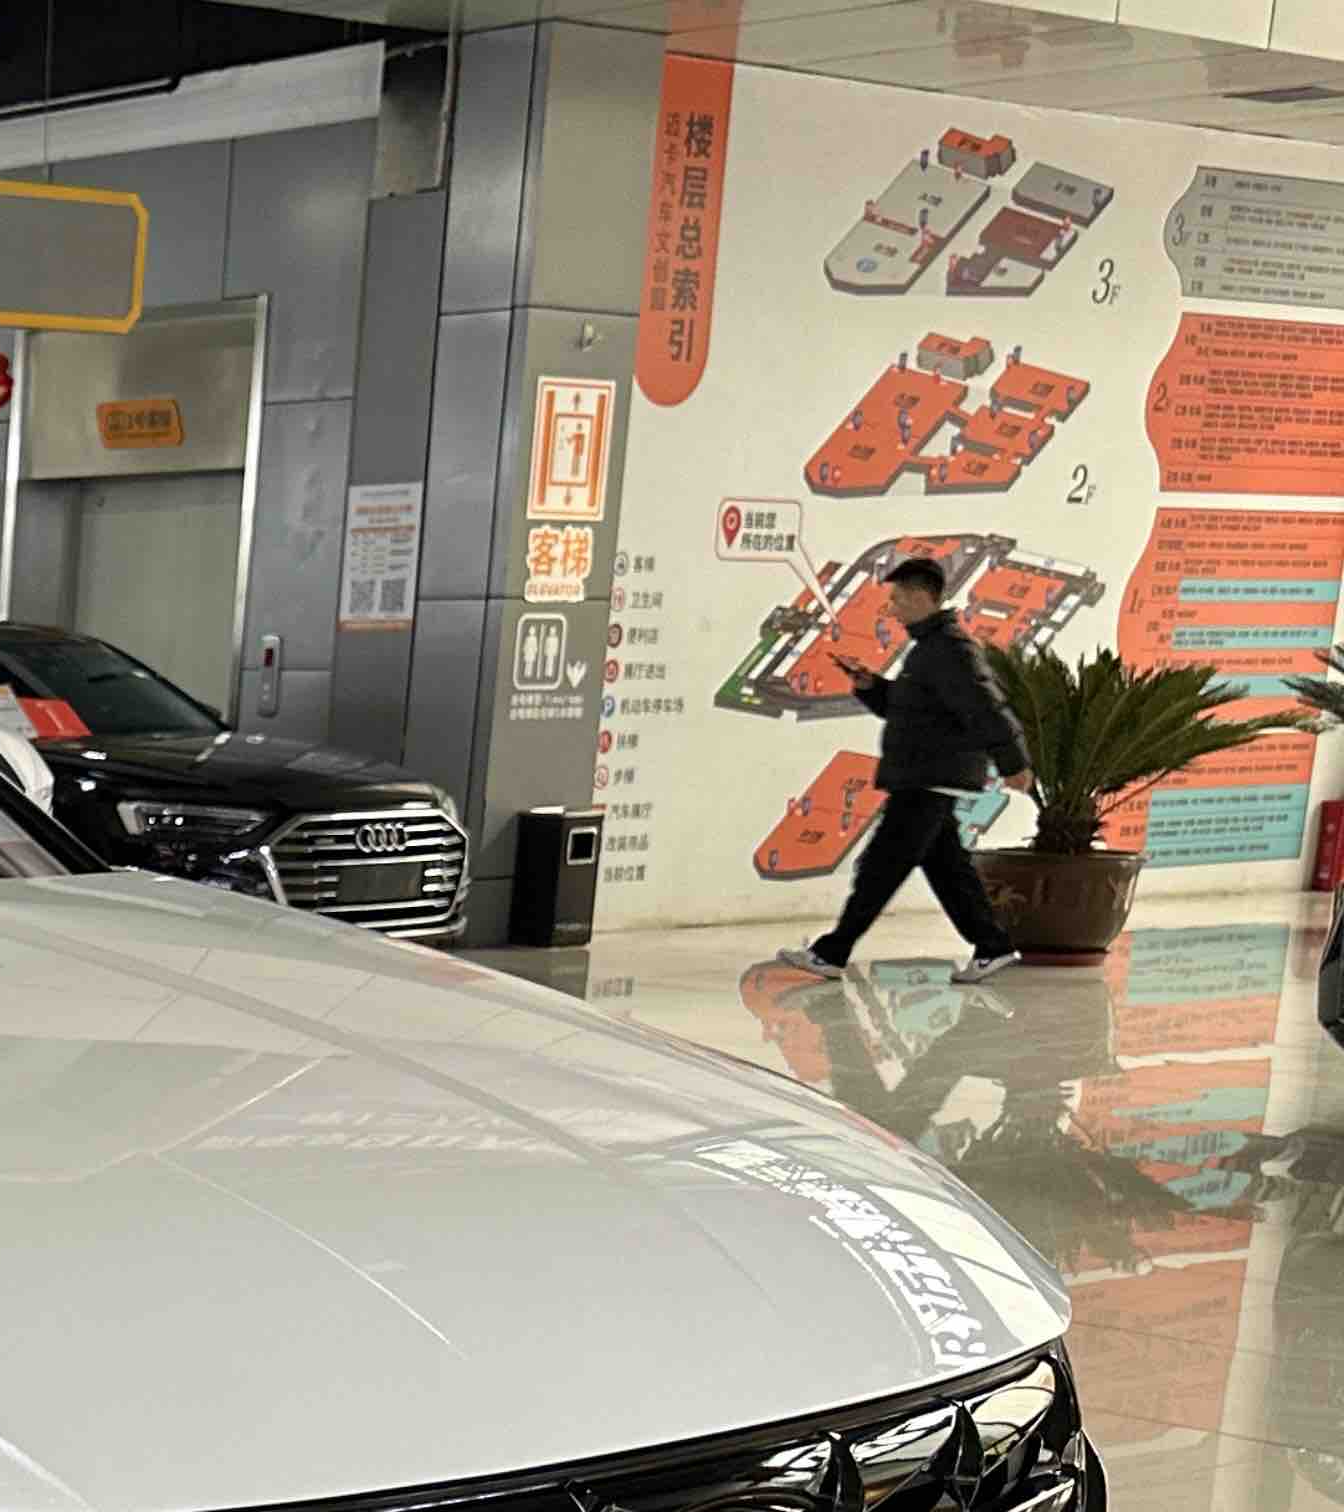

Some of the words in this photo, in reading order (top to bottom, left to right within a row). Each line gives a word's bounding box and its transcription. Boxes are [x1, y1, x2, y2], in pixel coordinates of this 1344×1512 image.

[668, 111, 714, 363] 楼层总索引
[529, 528, 592, 578] 客梯
